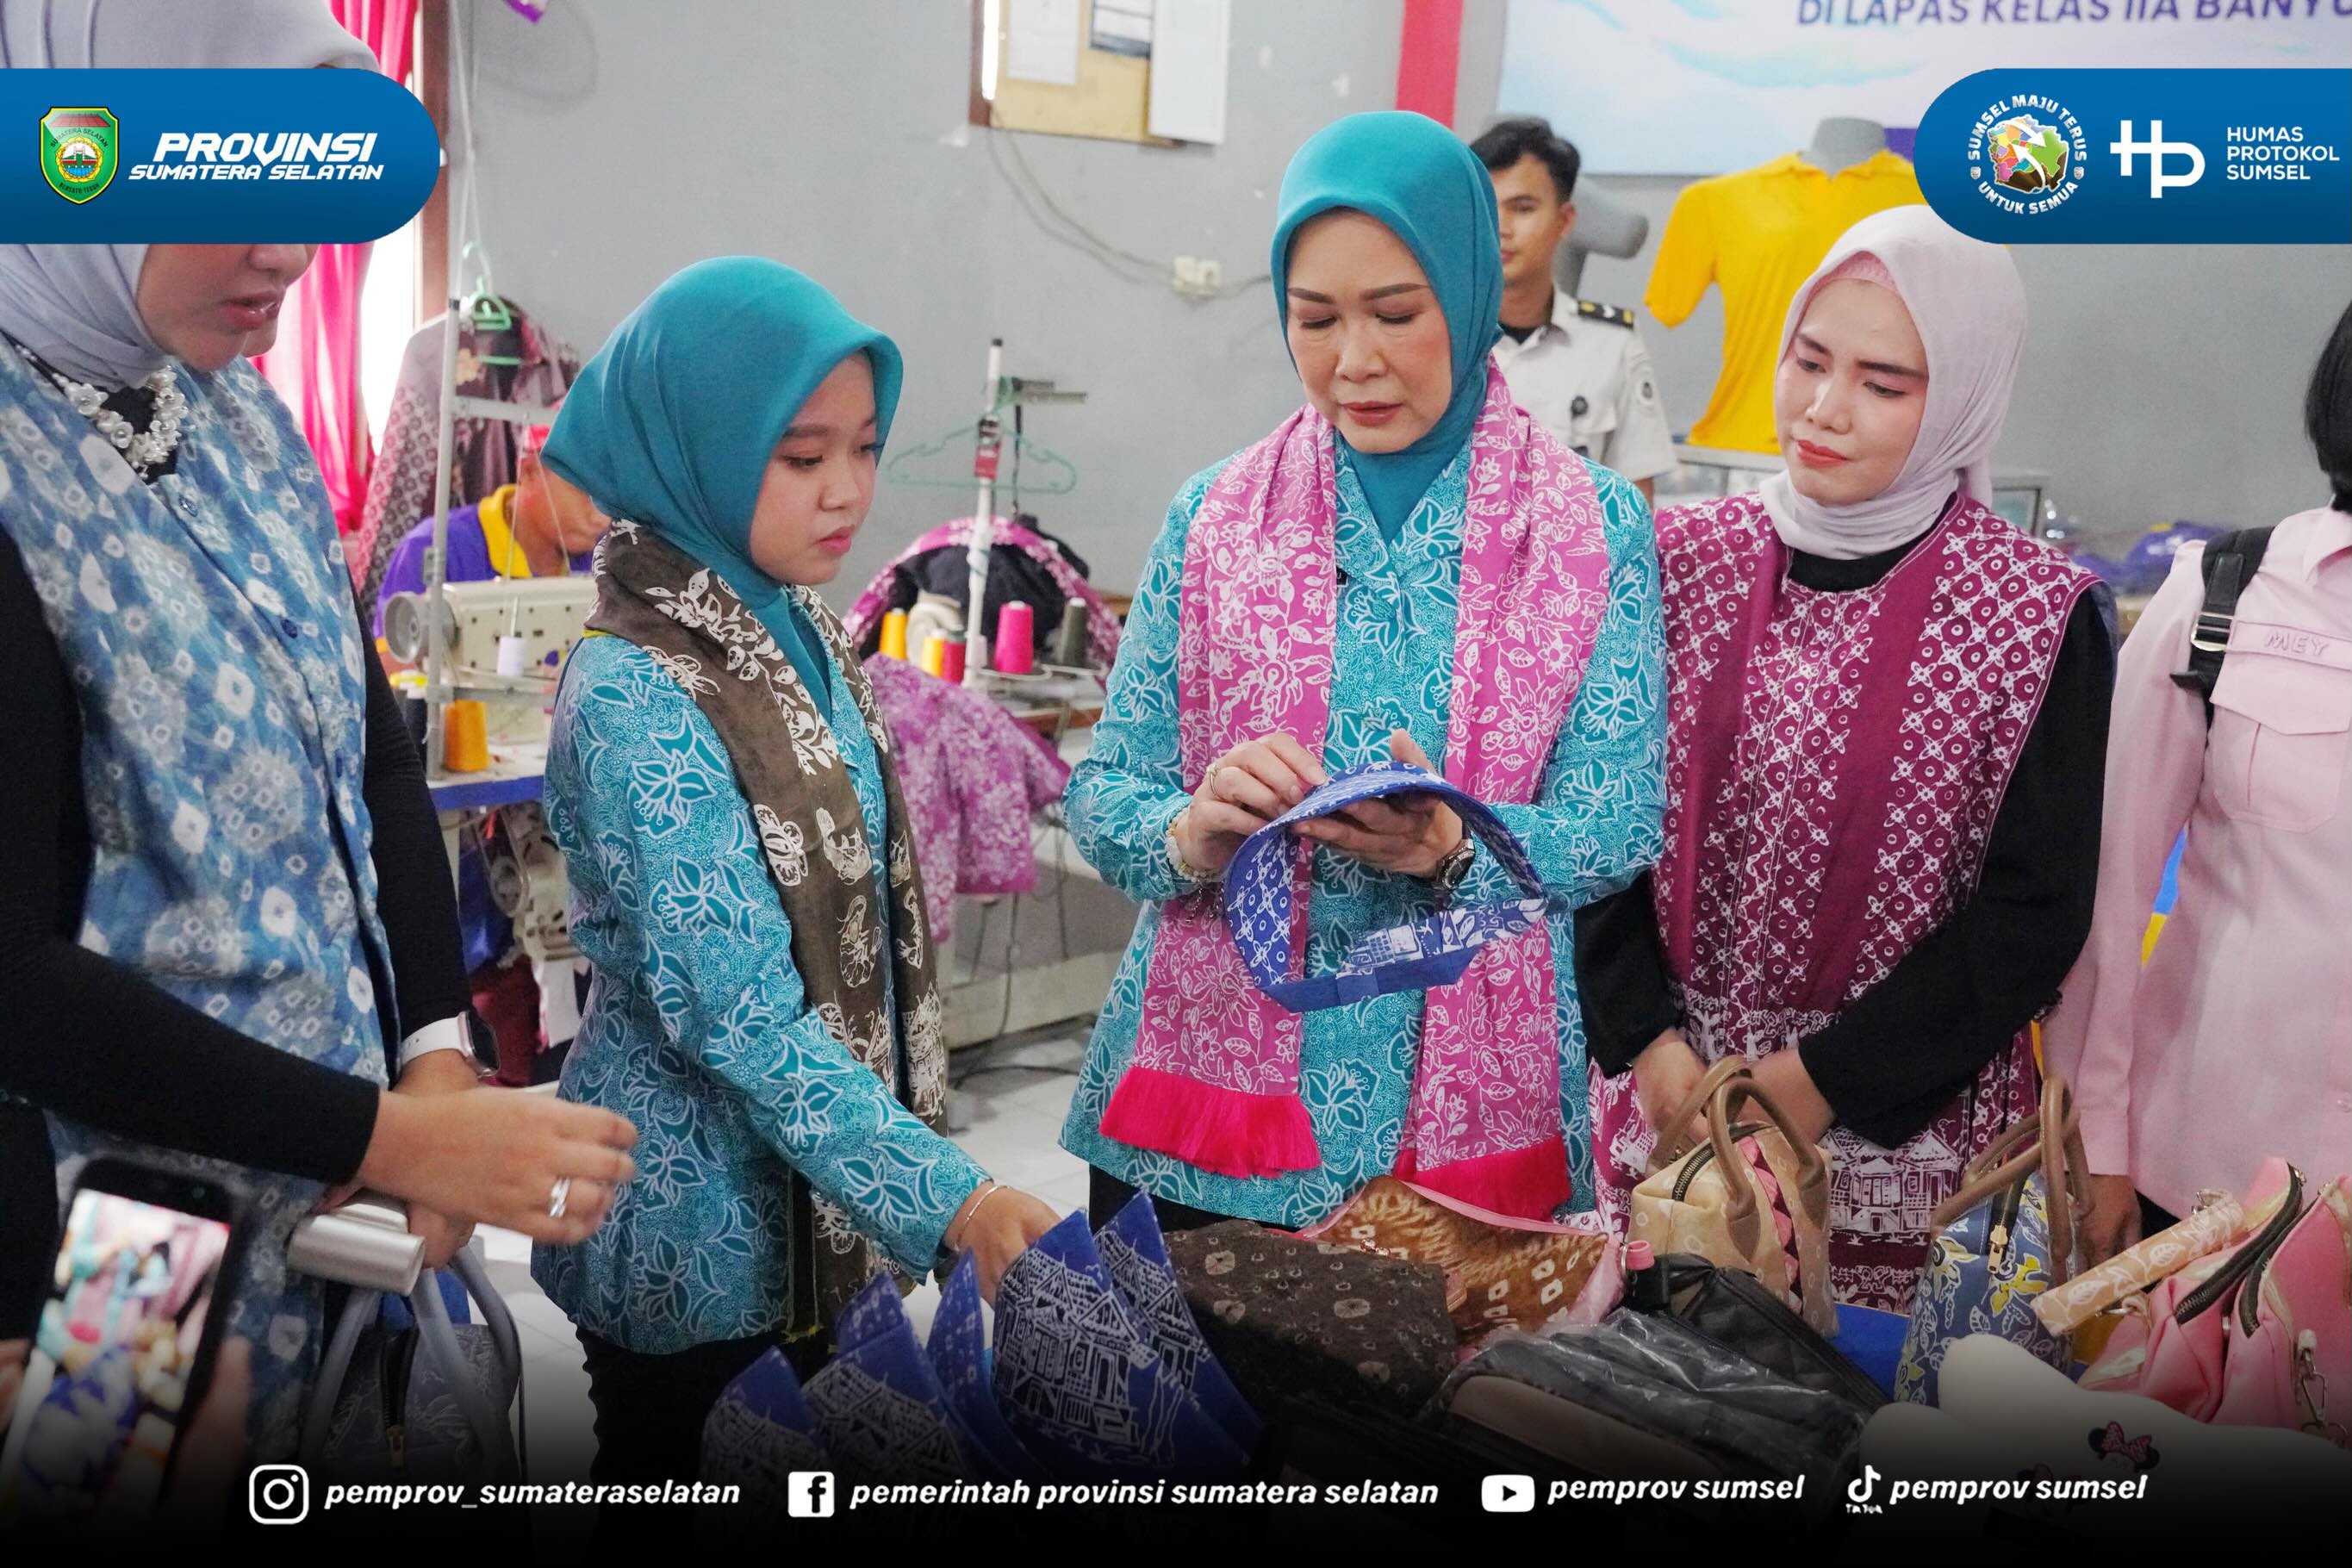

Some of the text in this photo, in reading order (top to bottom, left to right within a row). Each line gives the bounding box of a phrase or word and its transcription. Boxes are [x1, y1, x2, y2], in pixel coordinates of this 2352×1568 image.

[1797, 0, 1832, 24] DI
[1845, 0, 1968, 24] LAPAS
[1982, 0, 2110, 23] KELAS
[2267, 631, 2330, 656] MEY
